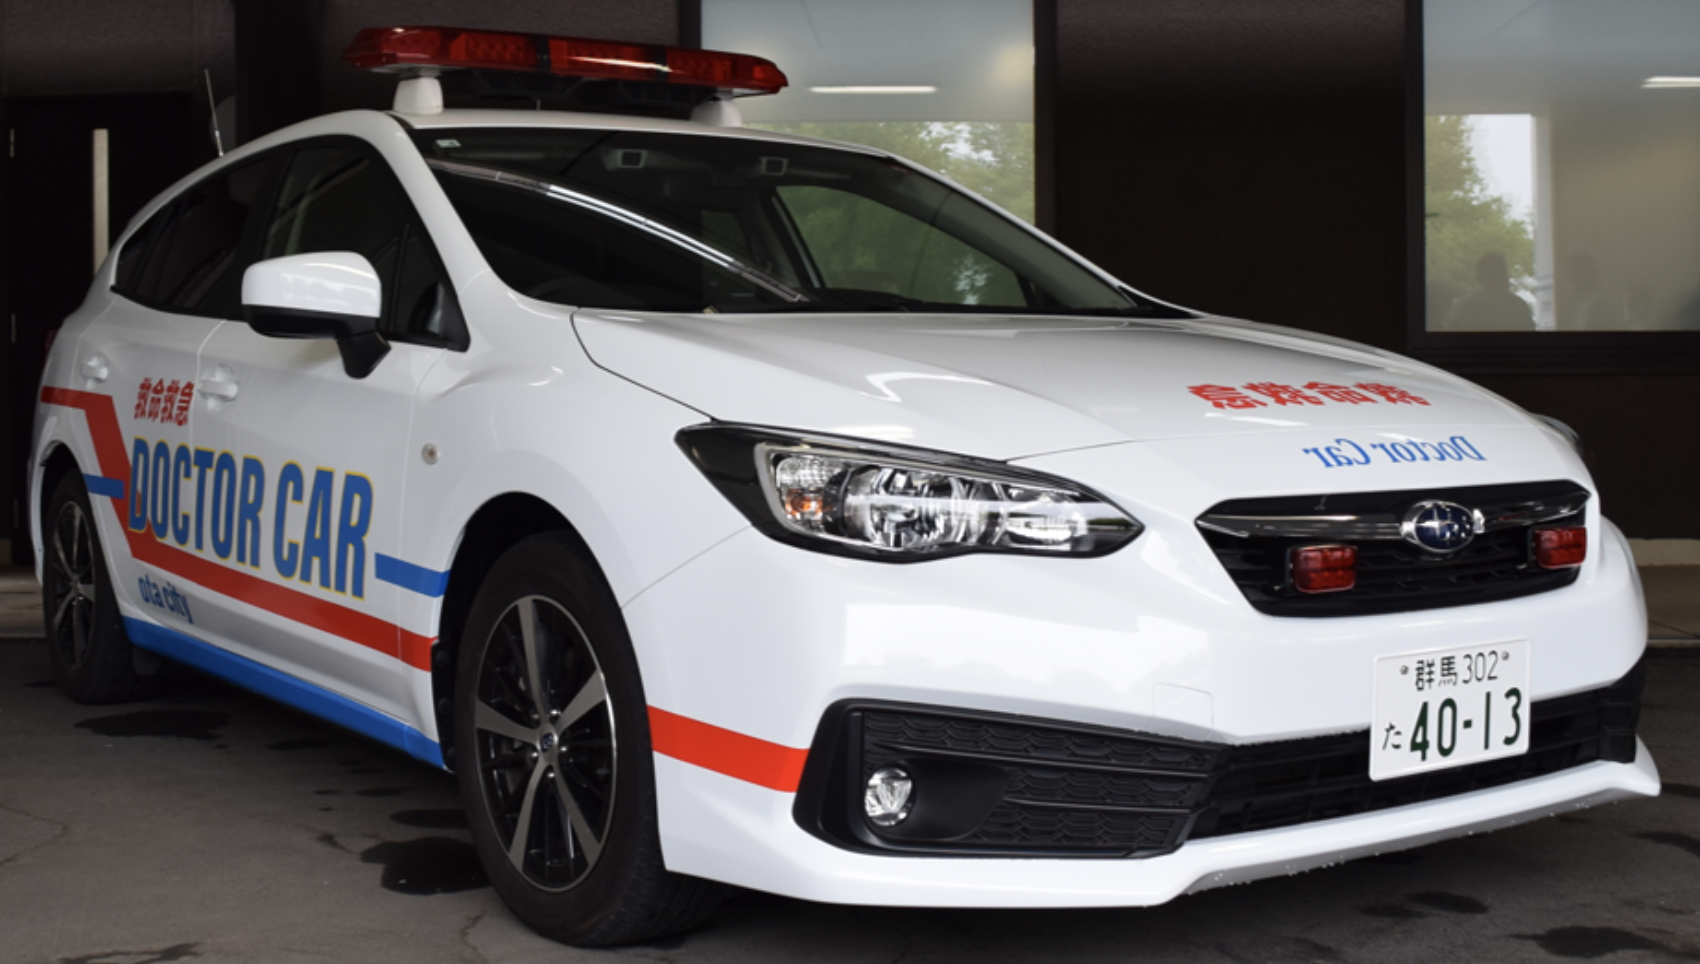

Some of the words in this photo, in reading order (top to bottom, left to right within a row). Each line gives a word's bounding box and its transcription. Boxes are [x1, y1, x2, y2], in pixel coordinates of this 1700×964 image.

[134, 377, 195, 426] 救命救急
[128, 436, 265, 570] DOCTOR
[272, 460, 374, 600] CAR
[138, 574, 165, 609] ota
[162, 581, 195, 625] city
[1382, 722, 1403, 751] た
[1410, 687, 1523, 762] 40-13
